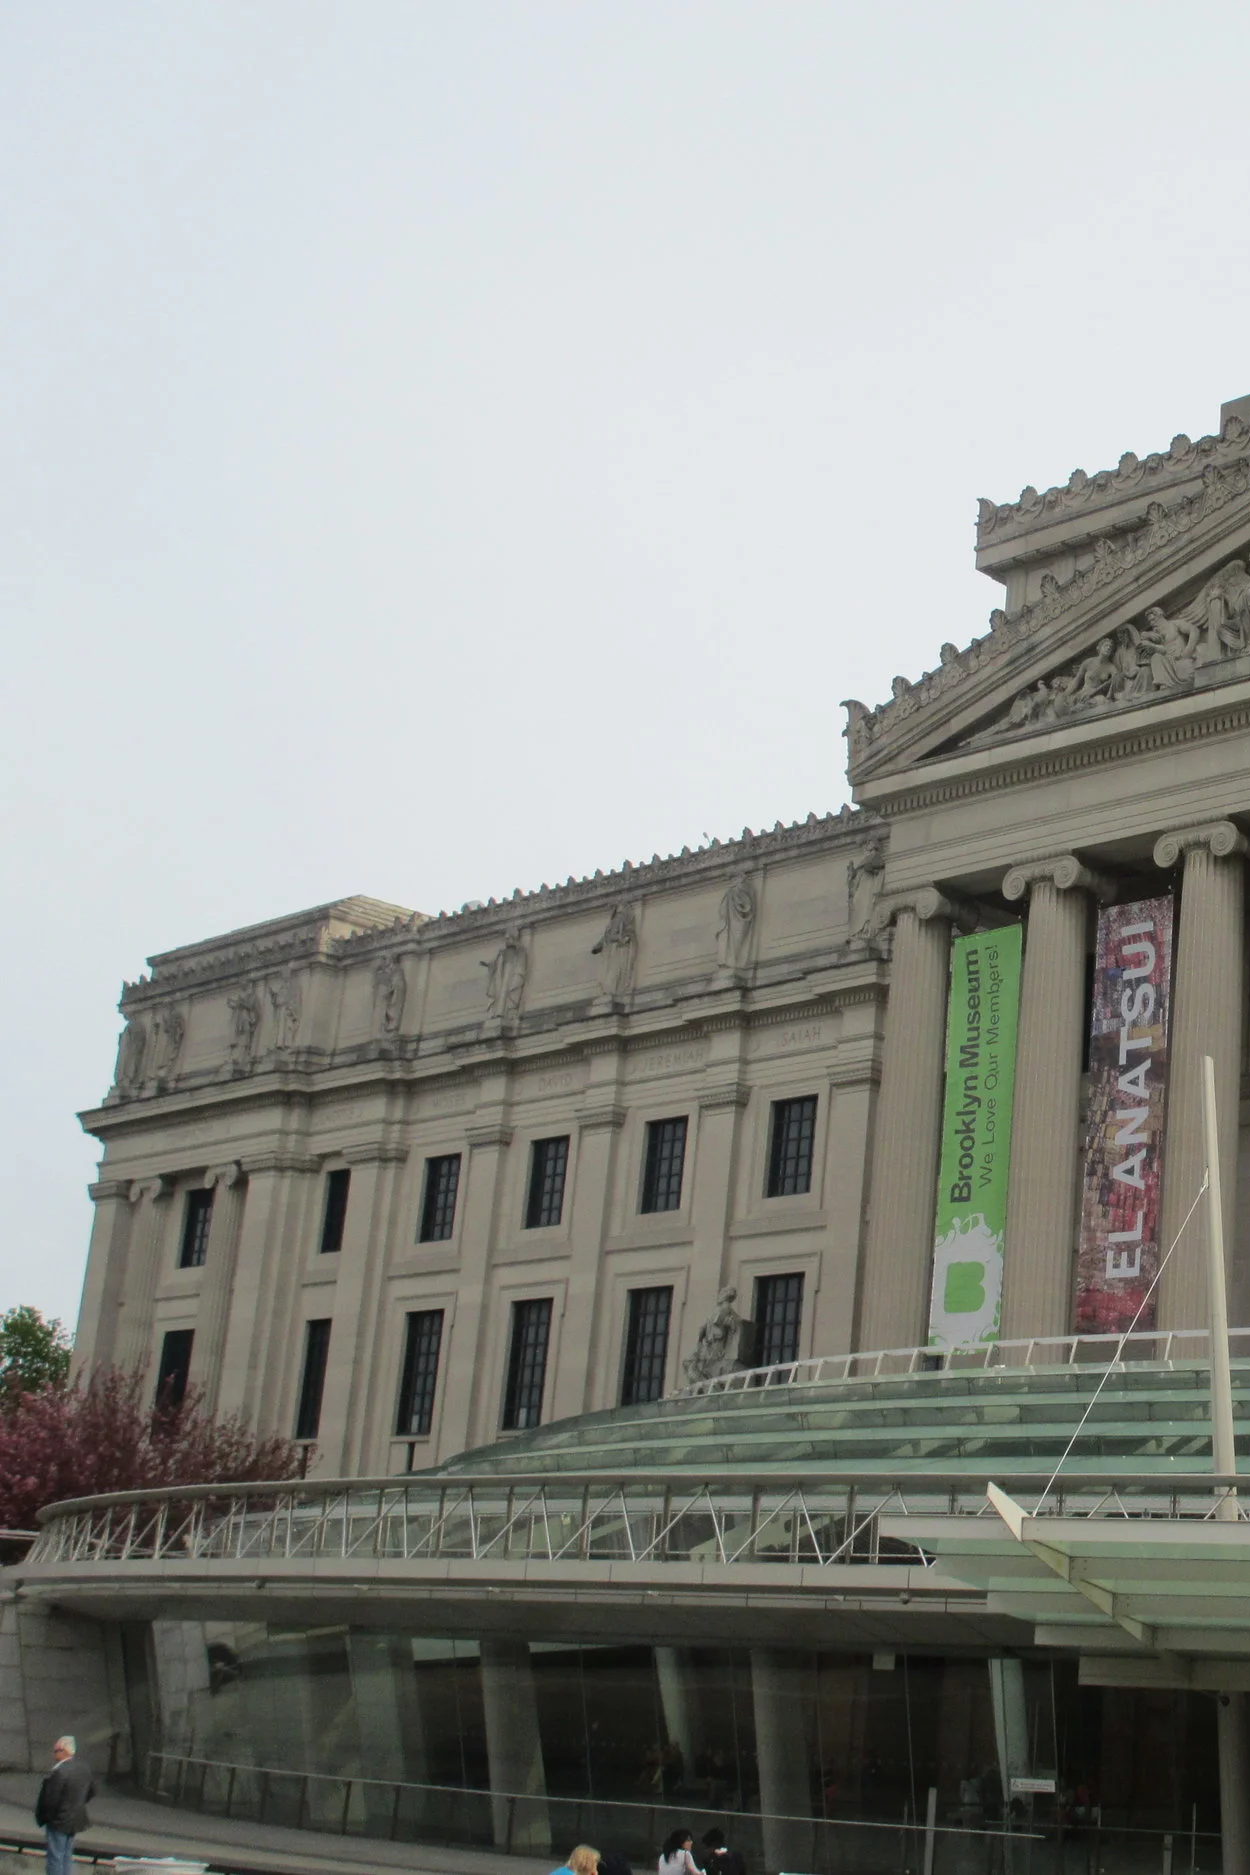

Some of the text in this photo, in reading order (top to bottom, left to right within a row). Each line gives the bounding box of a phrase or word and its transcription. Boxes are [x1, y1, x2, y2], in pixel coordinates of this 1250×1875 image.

[950, 948, 982, 1204] Brooklyn Museum
[978, 944, 1001, 1189] We Love Our Members!
[1105, 919, 1156, 1279] EL ANATSUI
